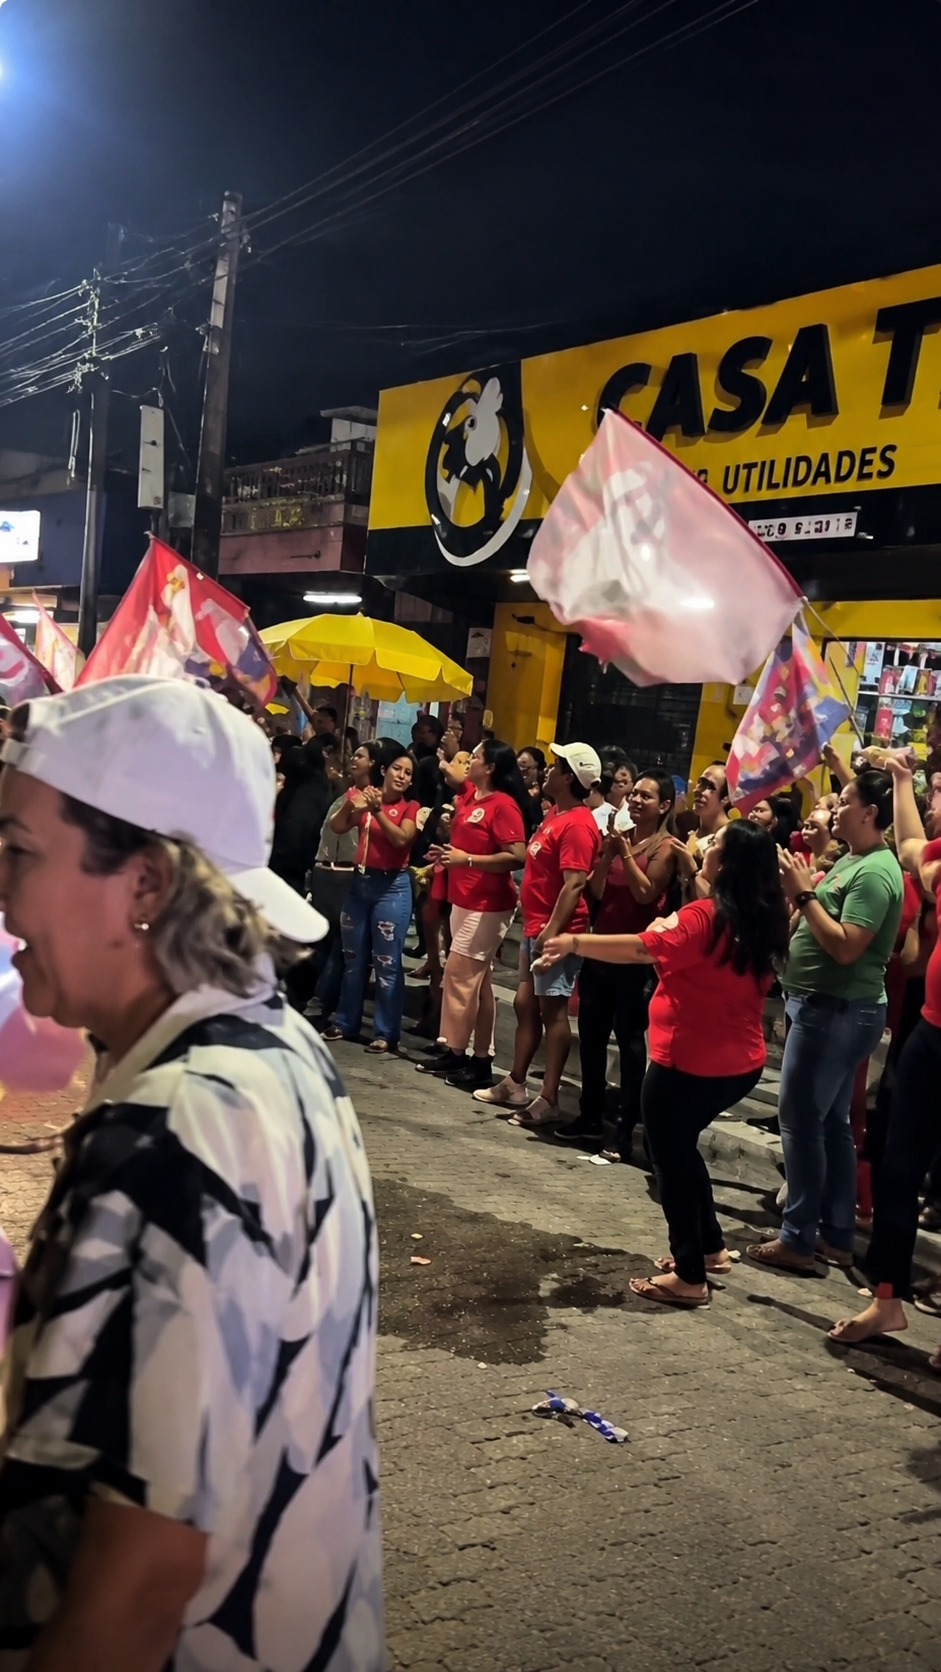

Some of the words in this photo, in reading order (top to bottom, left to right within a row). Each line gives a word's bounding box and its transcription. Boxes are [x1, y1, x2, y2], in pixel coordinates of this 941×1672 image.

[597, 323, 839, 443] CASA
[875, 296, 941, 407] T
[722, 444, 898, 495] UTILIDADES
